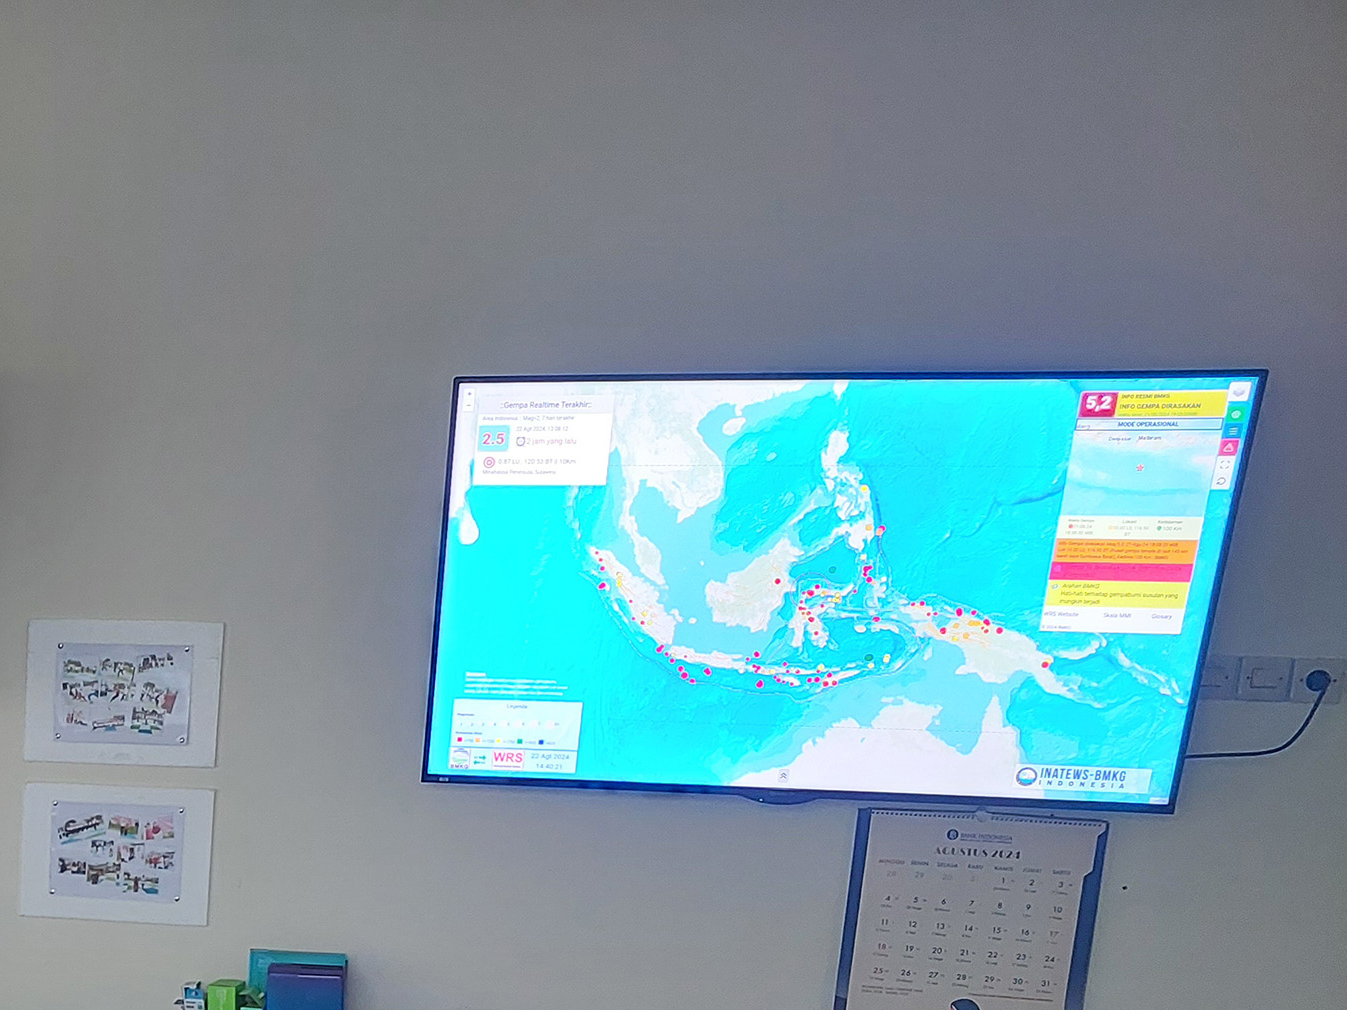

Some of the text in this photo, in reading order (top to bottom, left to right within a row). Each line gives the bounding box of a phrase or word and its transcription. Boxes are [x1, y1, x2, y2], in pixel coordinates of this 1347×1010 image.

[1085, 395, 1112, 412] 5,2
[482, 433, 505, 445] 2.5
[532, 438, 545, 446] jam
[546, 438, 563, 446] yang
[494, 752, 523, 763] WRS
[1040, 768, 1127, 782] INATEWS-BMKG
[1039, 780, 1124, 789] INDONESIA
[934, 847, 1021, 860] AGUSTUS 2024
